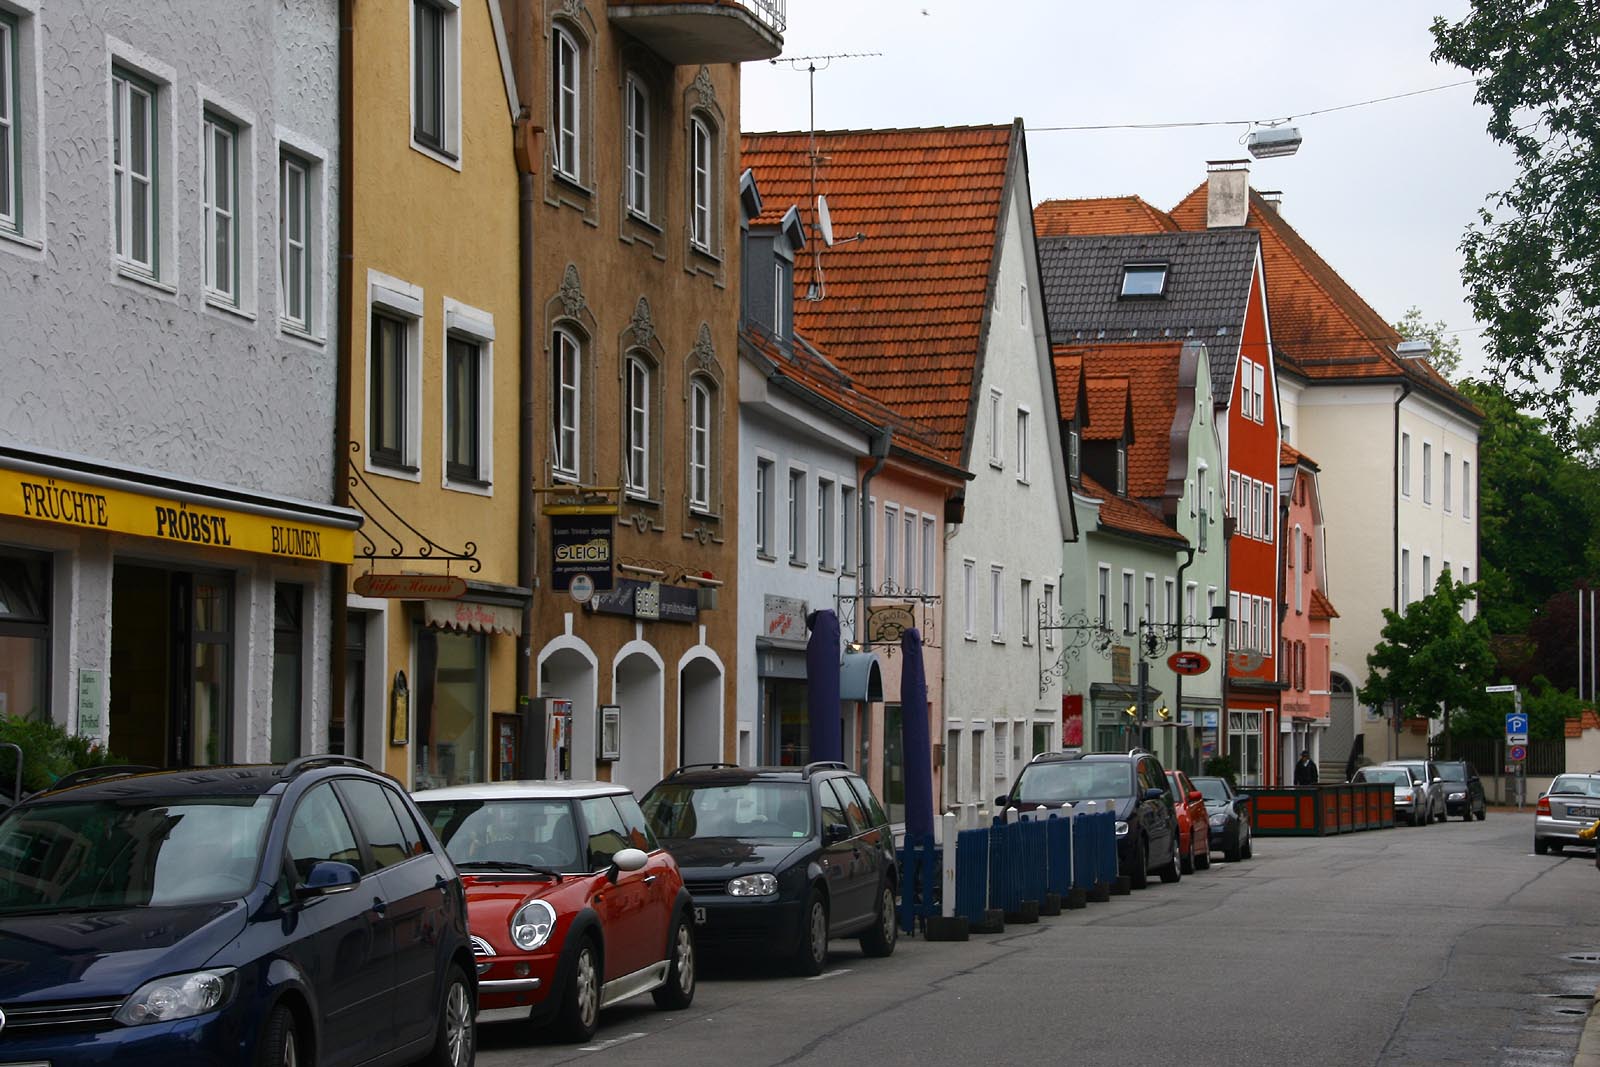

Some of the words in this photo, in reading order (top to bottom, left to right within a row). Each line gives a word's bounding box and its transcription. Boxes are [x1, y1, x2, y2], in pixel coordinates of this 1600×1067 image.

[21, 480, 108, 526] FRÜCHTE
[155, 501, 231, 545] PRÖBSTL
[271, 526, 321, 557] BLUMEN
[556, 546, 607, 559] GLEICH
[1513, 720, 1521, 732] P
